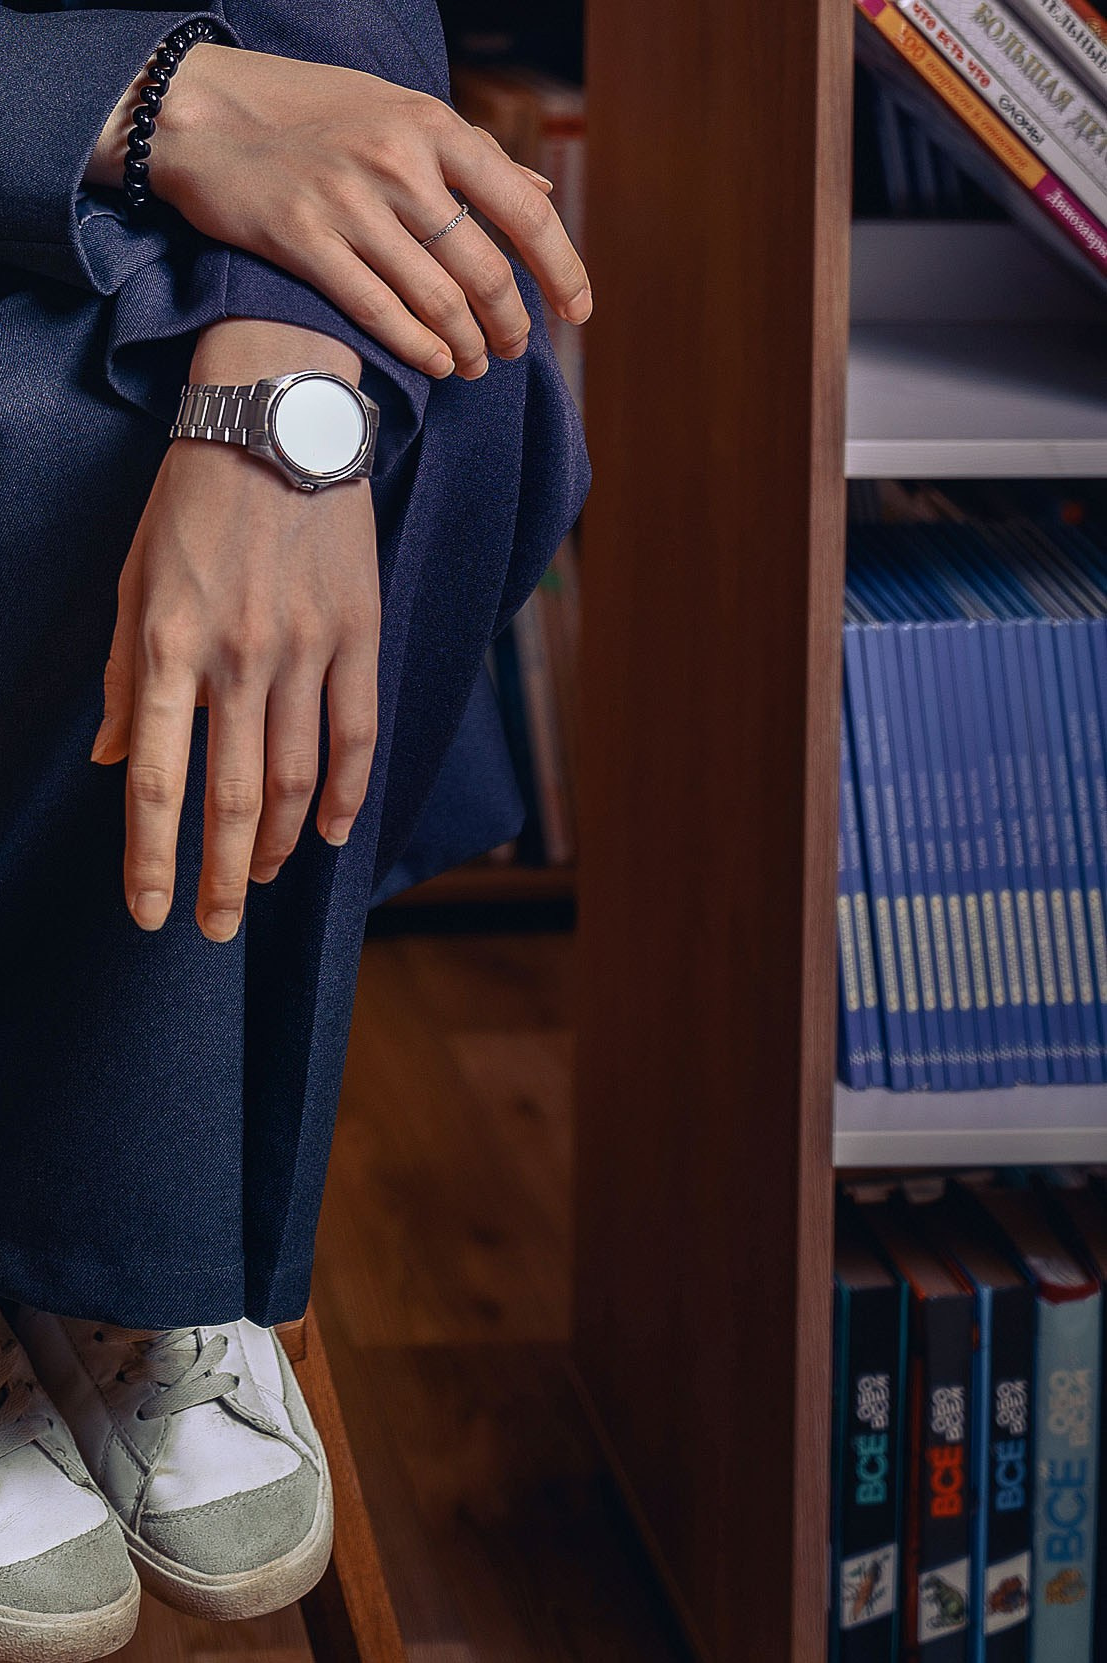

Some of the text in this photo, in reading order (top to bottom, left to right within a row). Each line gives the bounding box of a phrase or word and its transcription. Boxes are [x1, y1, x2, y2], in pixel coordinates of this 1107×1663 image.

[913, 2, 1045, 147] ЧТО ЕСТЬ ЧТО СЛОНЫ
[971, 1, 1107, 164] БОЛЬШАЯ ДЕТ
[1046, 189, 1107, 259] Динозавры
